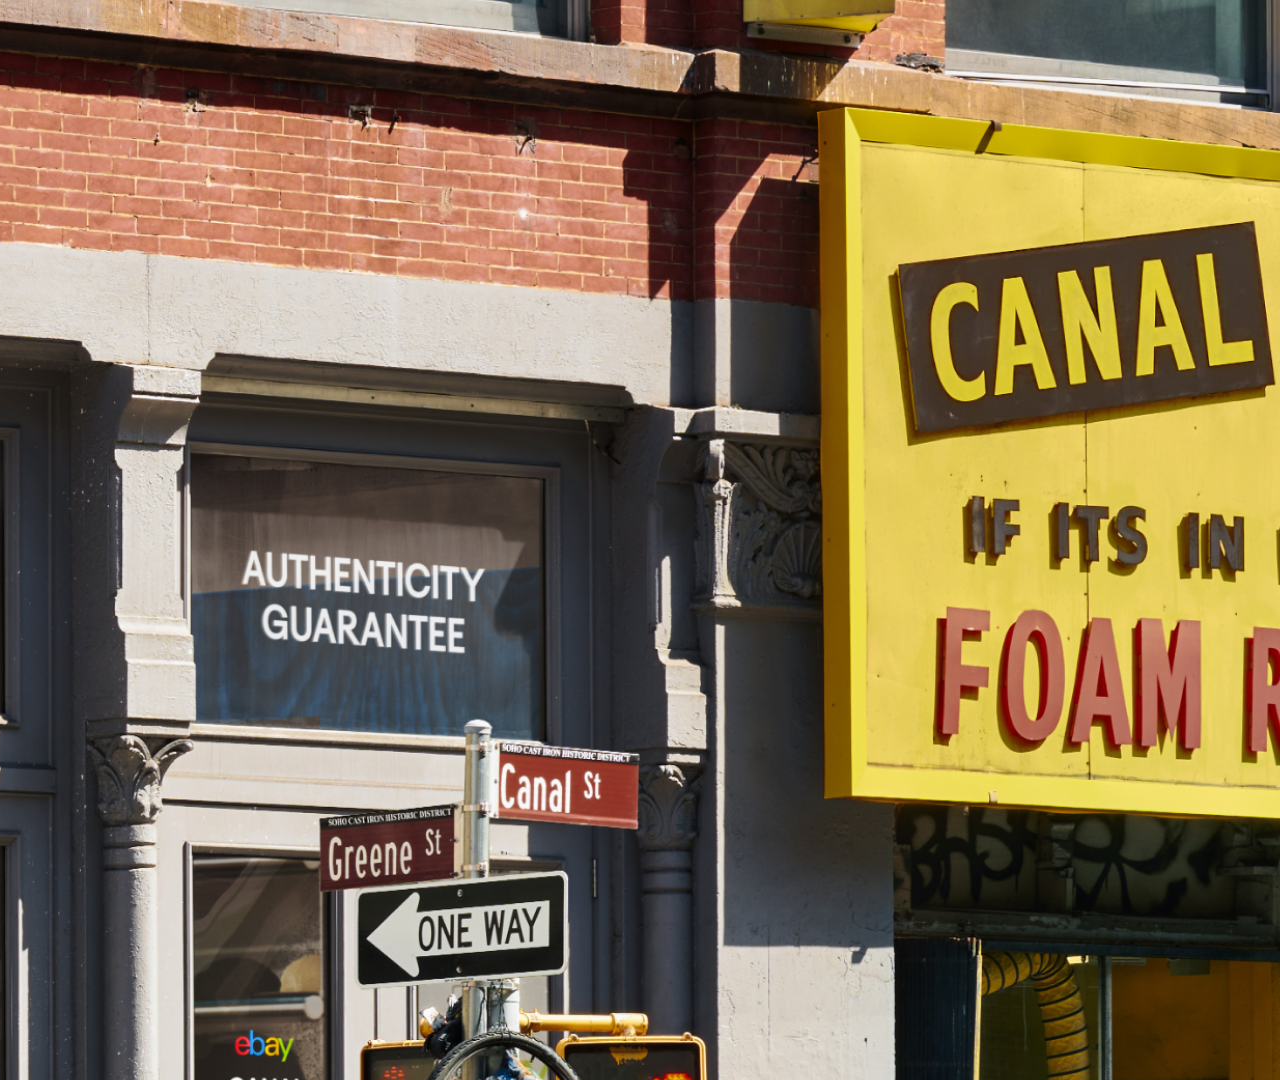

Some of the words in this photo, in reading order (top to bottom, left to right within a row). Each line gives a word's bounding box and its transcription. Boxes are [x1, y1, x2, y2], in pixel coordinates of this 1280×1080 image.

[929, 252, 1255, 402] CANAL
[964, 495, 1021, 557] IF
[1055, 501, 1148, 567] ITS
[1186, 511, 1245, 573] IN
[241, 550, 486, 604] AUTHENTICITY
[261, 603, 467, 655] GUARANTEE
[941, 606, 1201, 750] FOAM
[502, 744, 522, 754] SOHO
[523, 746, 542, 756] CAST
[543, 747, 561, 757] IRON
[562, 749, 596, 760] HISTORIC
[597, 752, 630, 763] DISTRICT
[501, 763, 571, 814] Canal
[583, 771, 601, 800] St
[328, 817, 347, 827] SOHO
[348, 816, 366, 826] CAST
[367, 814, 385, 824] IRON
[385, 811, 417, 822] HISTORIC
[419, 808, 452, 819] DISTRICT
[328, 836, 412, 881] Greene
[425, 828, 442, 856] St
[418, 912, 473, 953] ONE
[483, 906, 542, 945] WAY
[234, 1029, 294, 1062] ebay
